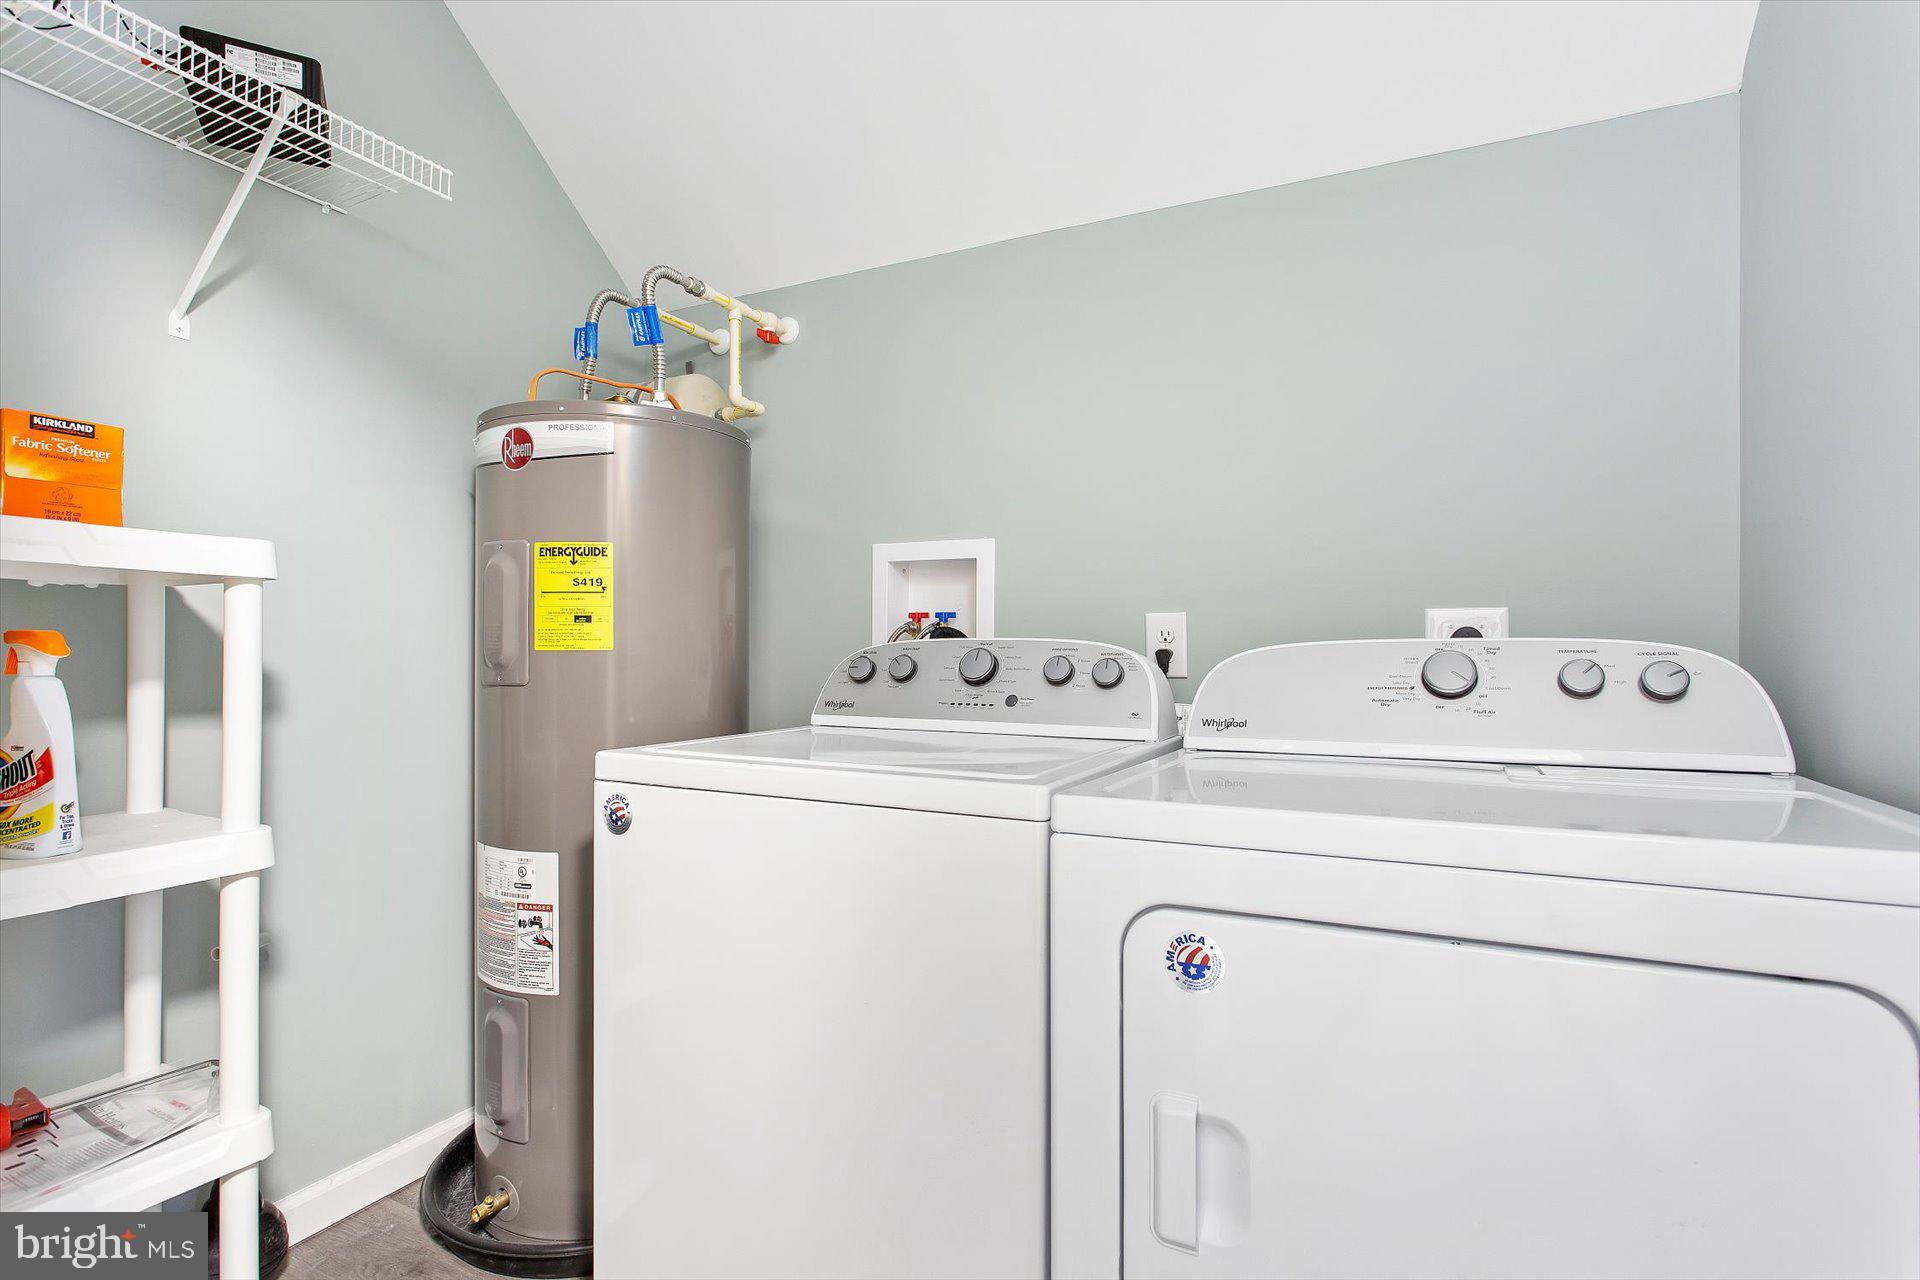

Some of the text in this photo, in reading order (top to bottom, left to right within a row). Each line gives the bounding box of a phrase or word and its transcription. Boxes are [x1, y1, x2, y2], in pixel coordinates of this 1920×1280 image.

[33, 416, 94, 433] KIRKLAND
[11, 435, 111, 459] Fabric Softener
[503, 428, 532, 463] Rheem
[539, 546, 608, 558] ENERGYGUIDE
[824, 700, 855, 711] Whirlpool
[1201, 718, 1247, 731] Whirlpool
[0, 749, 36, 792] HOUT
[20, 780, 37, 790] Acting
[604, 794, 629, 811] AMERICA
[0, 821, 41, 835] CENTRATED
[12, 816, 34, 827] MORE
[1166, 933, 1205, 972] AMERICA
